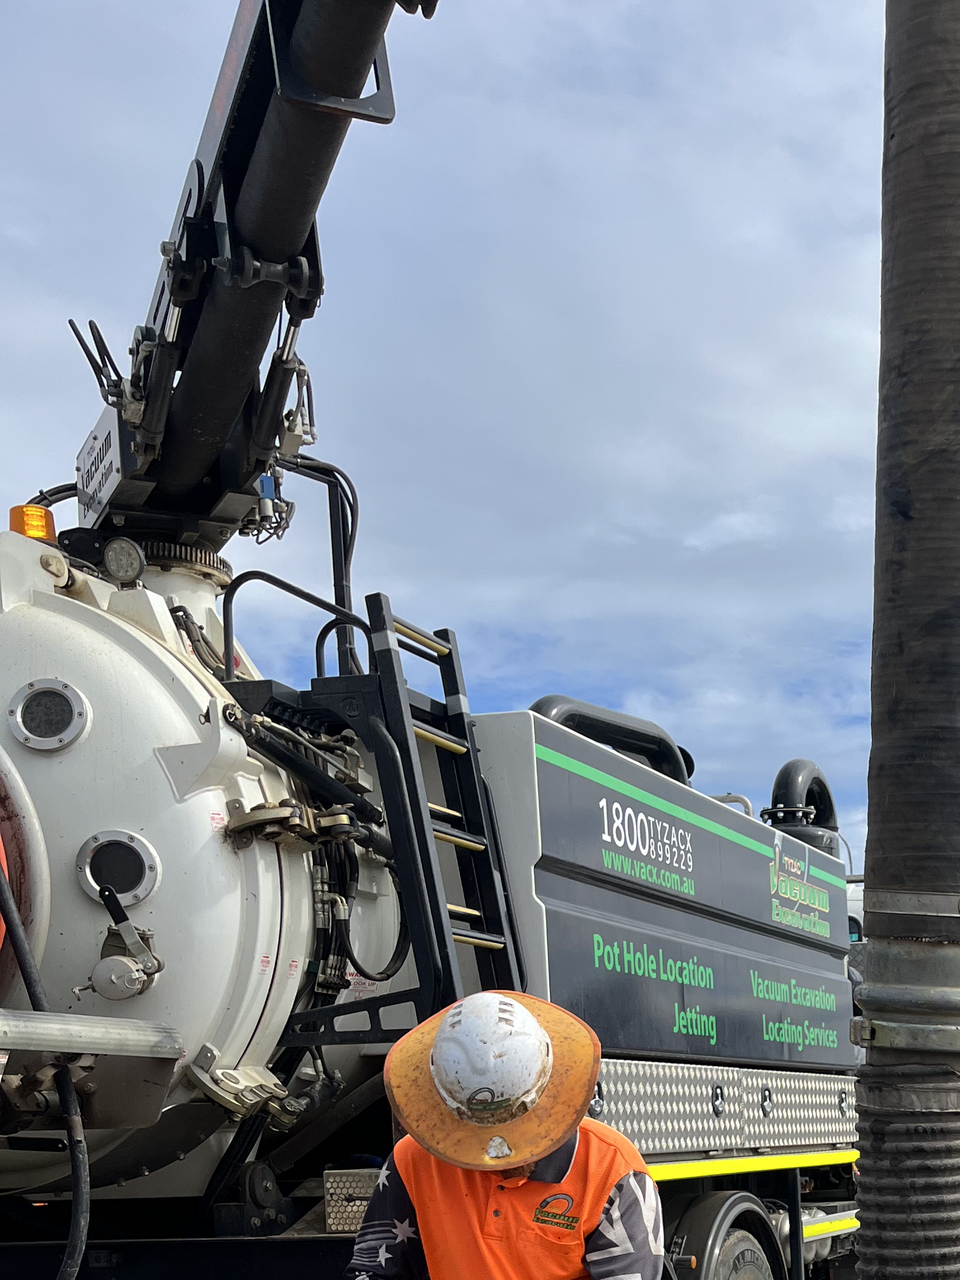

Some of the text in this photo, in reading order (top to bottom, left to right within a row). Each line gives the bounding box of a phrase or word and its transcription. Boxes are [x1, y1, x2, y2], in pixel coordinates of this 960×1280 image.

[599, 797, 693, 856] 1800 TYZACX
[602, 848, 695, 896] www.vacx.com.au
[649, 838, 693, 873] 899229
[769, 860, 830, 914] Vacuum
[771, 898, 831, 938] Excavation
[593, 933, 714, 990] Pot Hole Location
[749, 969, 837, 1012] Vacuum Excavation
[673, 1002, 717, 1046] Jetting
[762, 1013, 838, 1052] Locating Services
